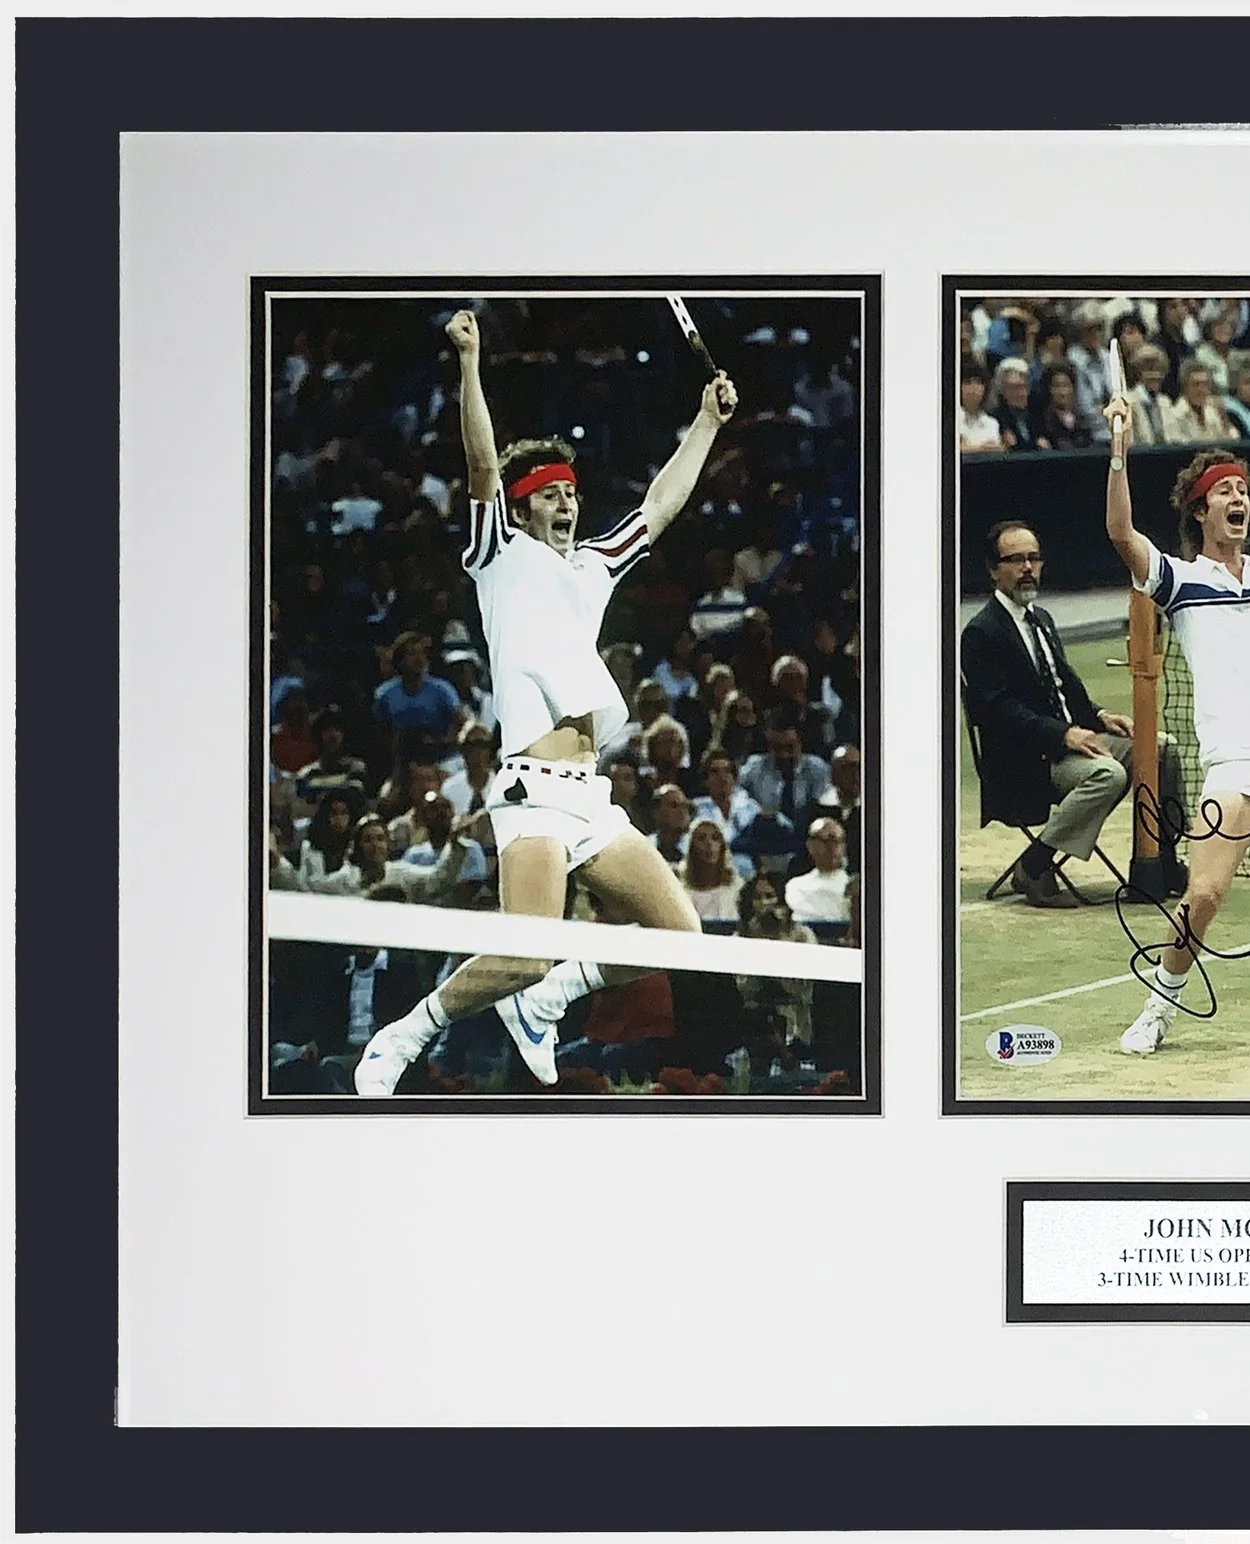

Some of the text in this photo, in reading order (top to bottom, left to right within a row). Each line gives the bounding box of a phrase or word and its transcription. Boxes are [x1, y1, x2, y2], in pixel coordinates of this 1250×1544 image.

[1017, 1039, 1055, 1051] A93898
[1142, 1217, 1213, 1239] JOHN
[1118, 1247, 1184, 1264] 4-TIME
[1190, 1247, 1214, 1264] US
[1097, 1271, 1163, 1287] 3-TIME
